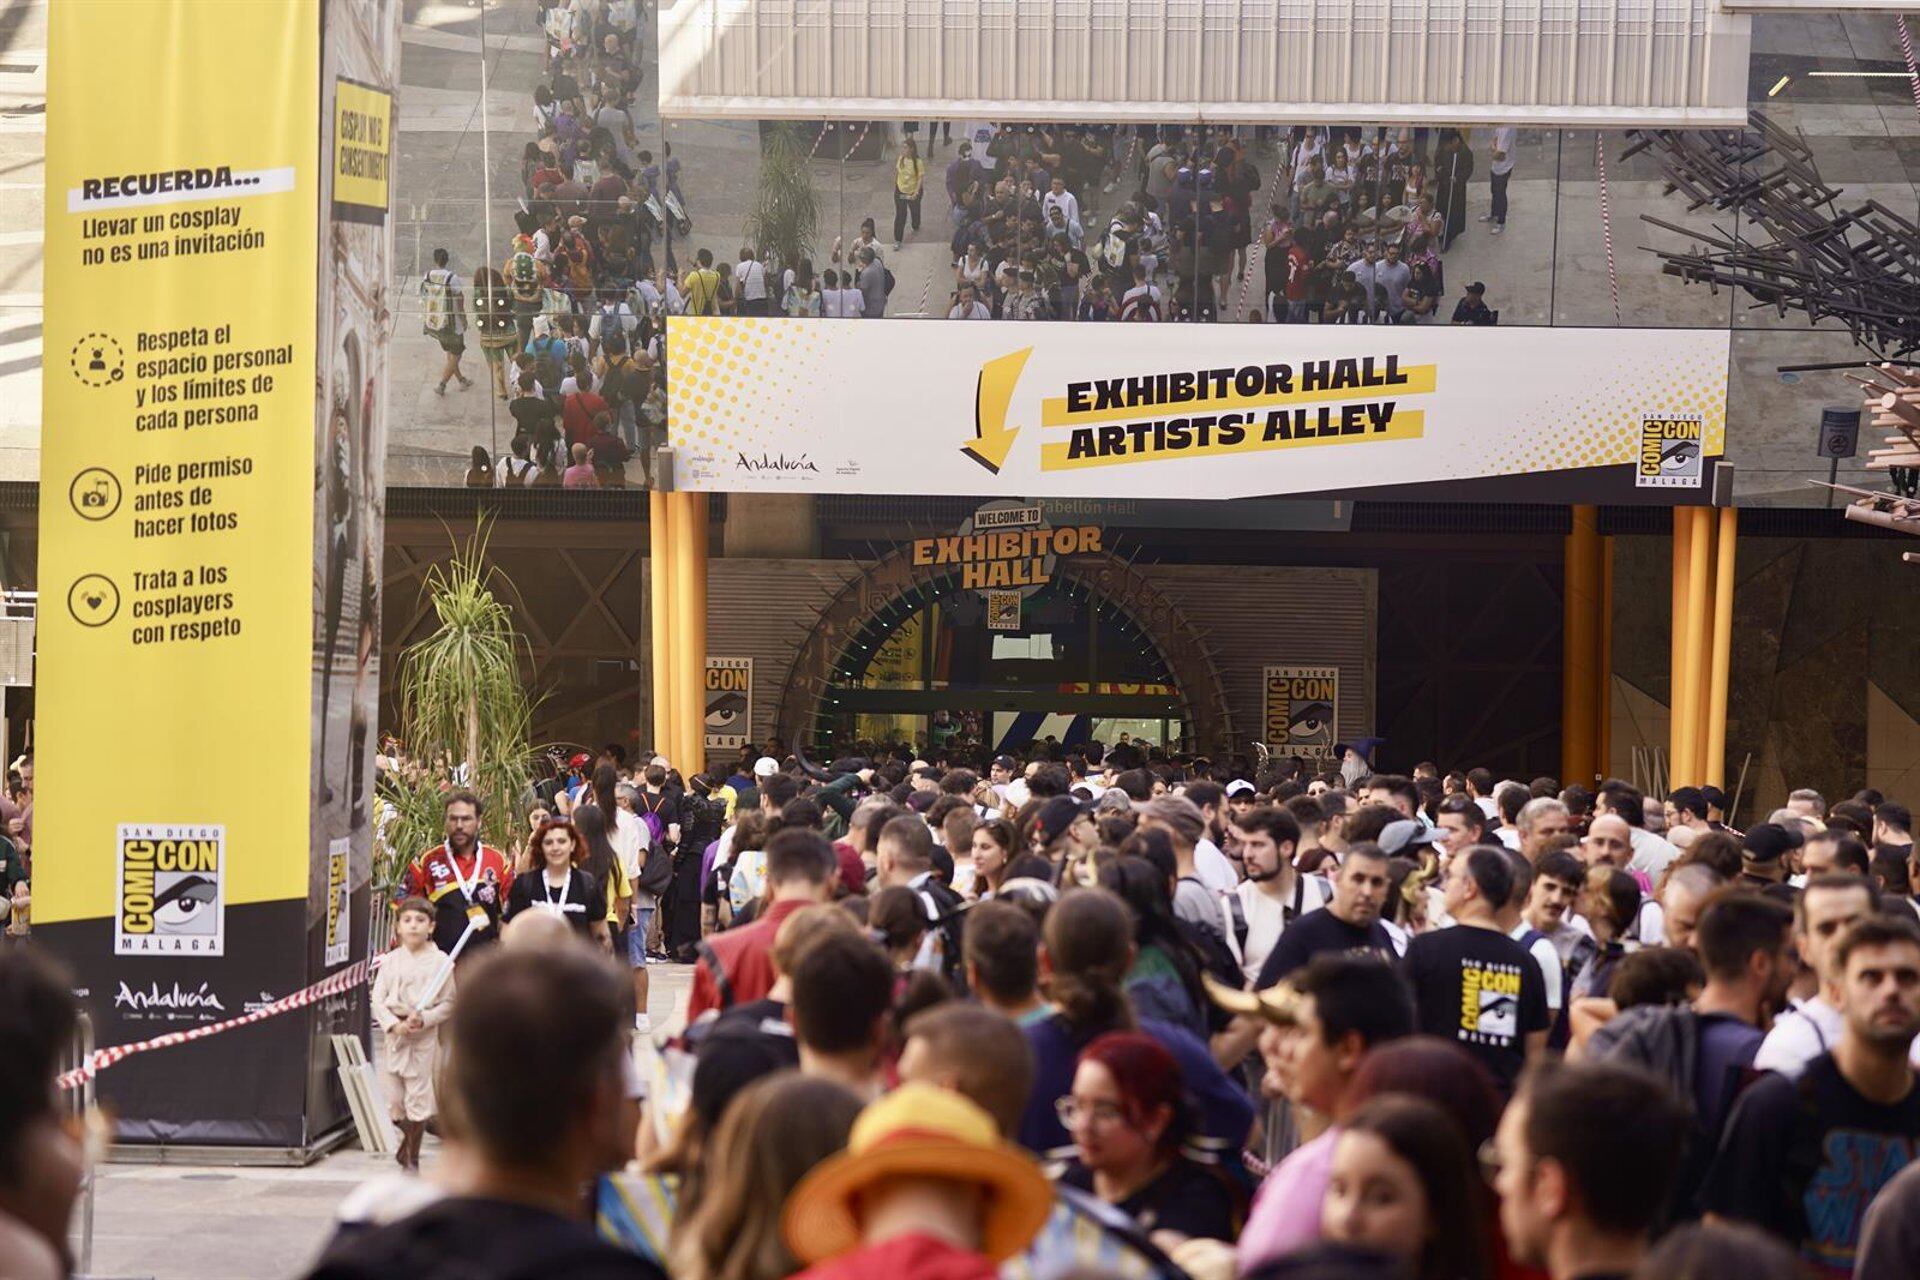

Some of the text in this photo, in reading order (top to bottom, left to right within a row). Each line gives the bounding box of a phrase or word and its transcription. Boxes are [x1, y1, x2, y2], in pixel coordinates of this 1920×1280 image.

[83, 166, 260, 200] RECUERDA...
[83, 206, 241, 239] Llevar un cosplay
[82, 228, 265, 265] no es una invitación
[137, 324, 230, 352] Respeta el
[136, 344, 293, 379] espacio personal
[136, 374, 273, 408] y los límites de
[1067, 355, 1408, 413] EXHIBITOR HALL
[136, 404, 258, 432] cada persona
[1067, 402, 1396, 459] ARTISTS' ALLEY
[1663, 421, 1700, 439] CON
[735, 452, 820, 472] Andalucía
[1641, 421, 1663, 475] COMIC
[135, 456, 253, 485] Pide permiso
[135, 486, 212, 511] antes de
[134, 511, 238, 538] hacer fotos
[978, 510, 1039, 525] WELCOME TO
[913, 526, 1102, 566] EXHIBITOR
[133, 565, 227, 591] Trata a los
[963, 557, 1050, 589] HALL
[133, 592, 233, 618] cosplayers
[133, 616, 241, 645] con respeto
[706, 668, 747, 690] CON
[1291, 679, 1333, 700] CON
[1268, 679, 1290, 744] COMIC
[706, 737, 746, 745] LAGA
[122, 829, 219, 837] SAN DIEGO
[157, 840, 217, 871] CON
[122, 841, 155, 933] COMIC
[115, 980, 225, 1010] Andalucía
[1481, 970, 1521, 995] CON
[1461, 967, 1480, 1031] COMIC
